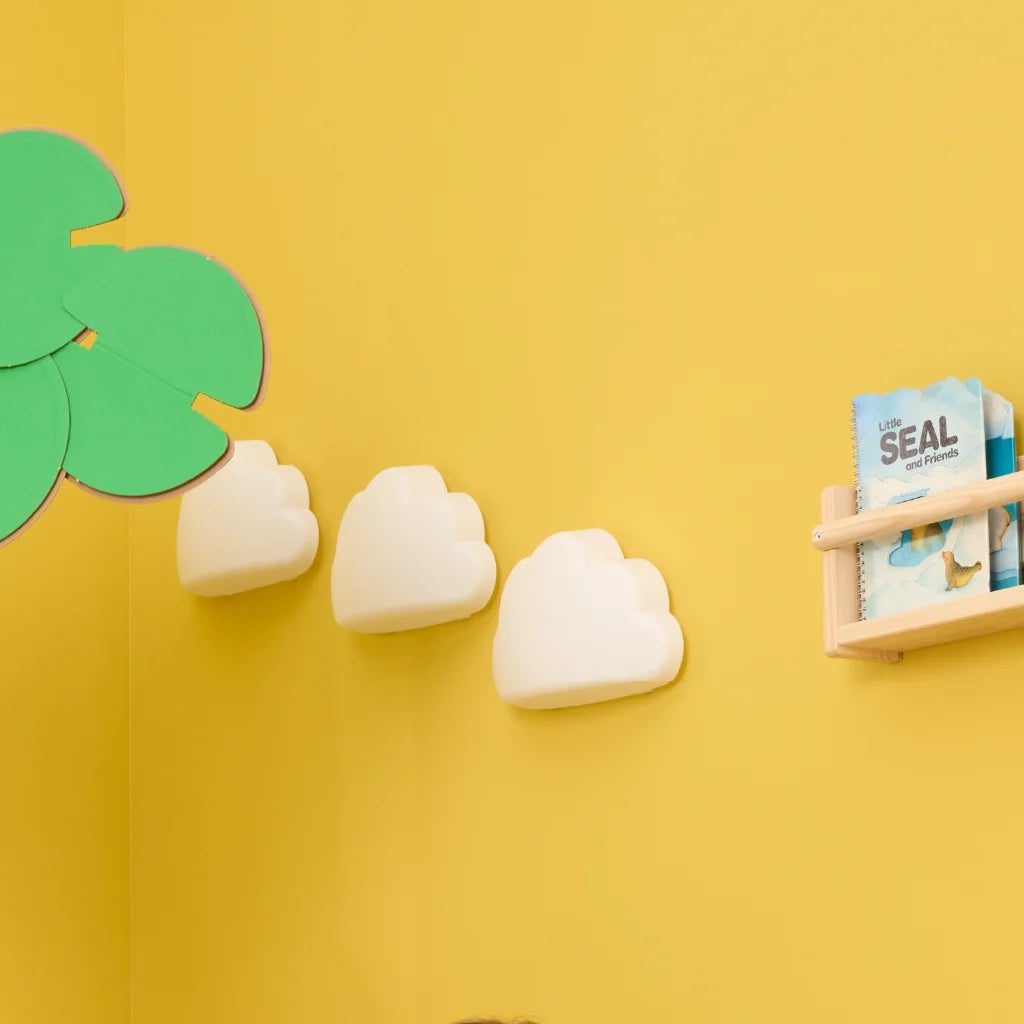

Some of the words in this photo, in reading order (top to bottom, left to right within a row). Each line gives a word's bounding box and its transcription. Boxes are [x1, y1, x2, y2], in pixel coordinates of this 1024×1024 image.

[879, 418, 902, 432] Little
[880, 415, 959, 466] SEAL
[905, 458, 923, 471] and
[924, 448, 959, 466] Friends
